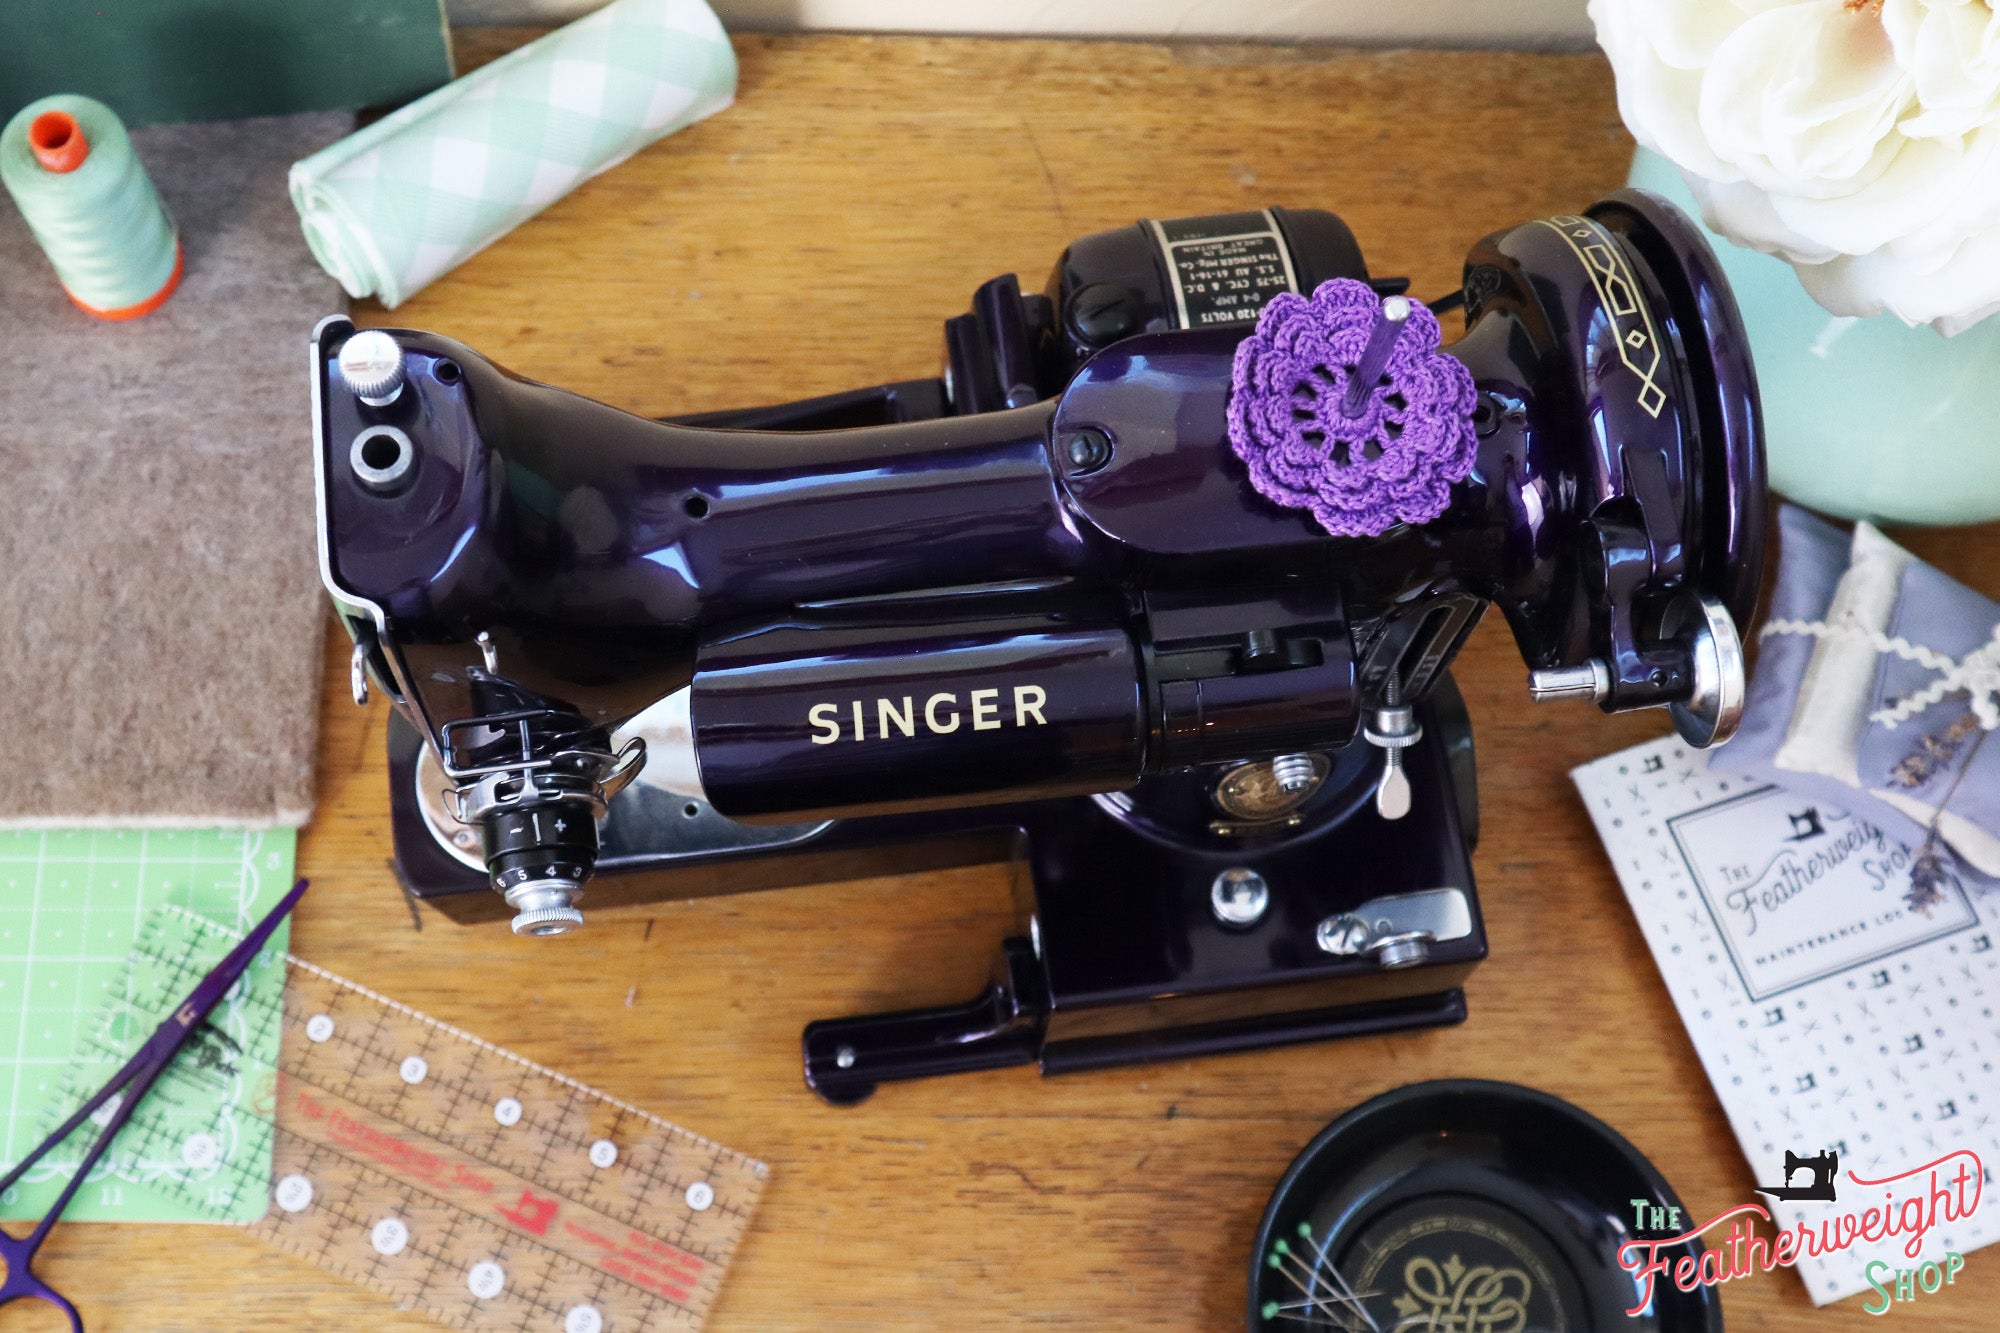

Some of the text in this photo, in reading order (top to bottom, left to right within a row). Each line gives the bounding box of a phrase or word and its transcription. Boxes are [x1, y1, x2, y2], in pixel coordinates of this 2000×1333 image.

[1219, 254, 1258, 266] SINGER
[1259, 252, 1278, 261] The
[1235, 267, 1250, 277] AU
[1256, 275, 1286, 286] 25-75
[1201, 312, 1235, 323] VOLTS
[808, 685, 1048, 745] SINGER
[517, 869, 528, 881] 5
[545, 865, 557, 877] 4
[572, 866, 583, 878] 3
[1720, 864, 1752, 884] THE
[1726, 820, 1887, 937] Featherweig
[1755, 920, 1868, 965] MAINTENANCE
[100, 1187, 124, 1206] 11
